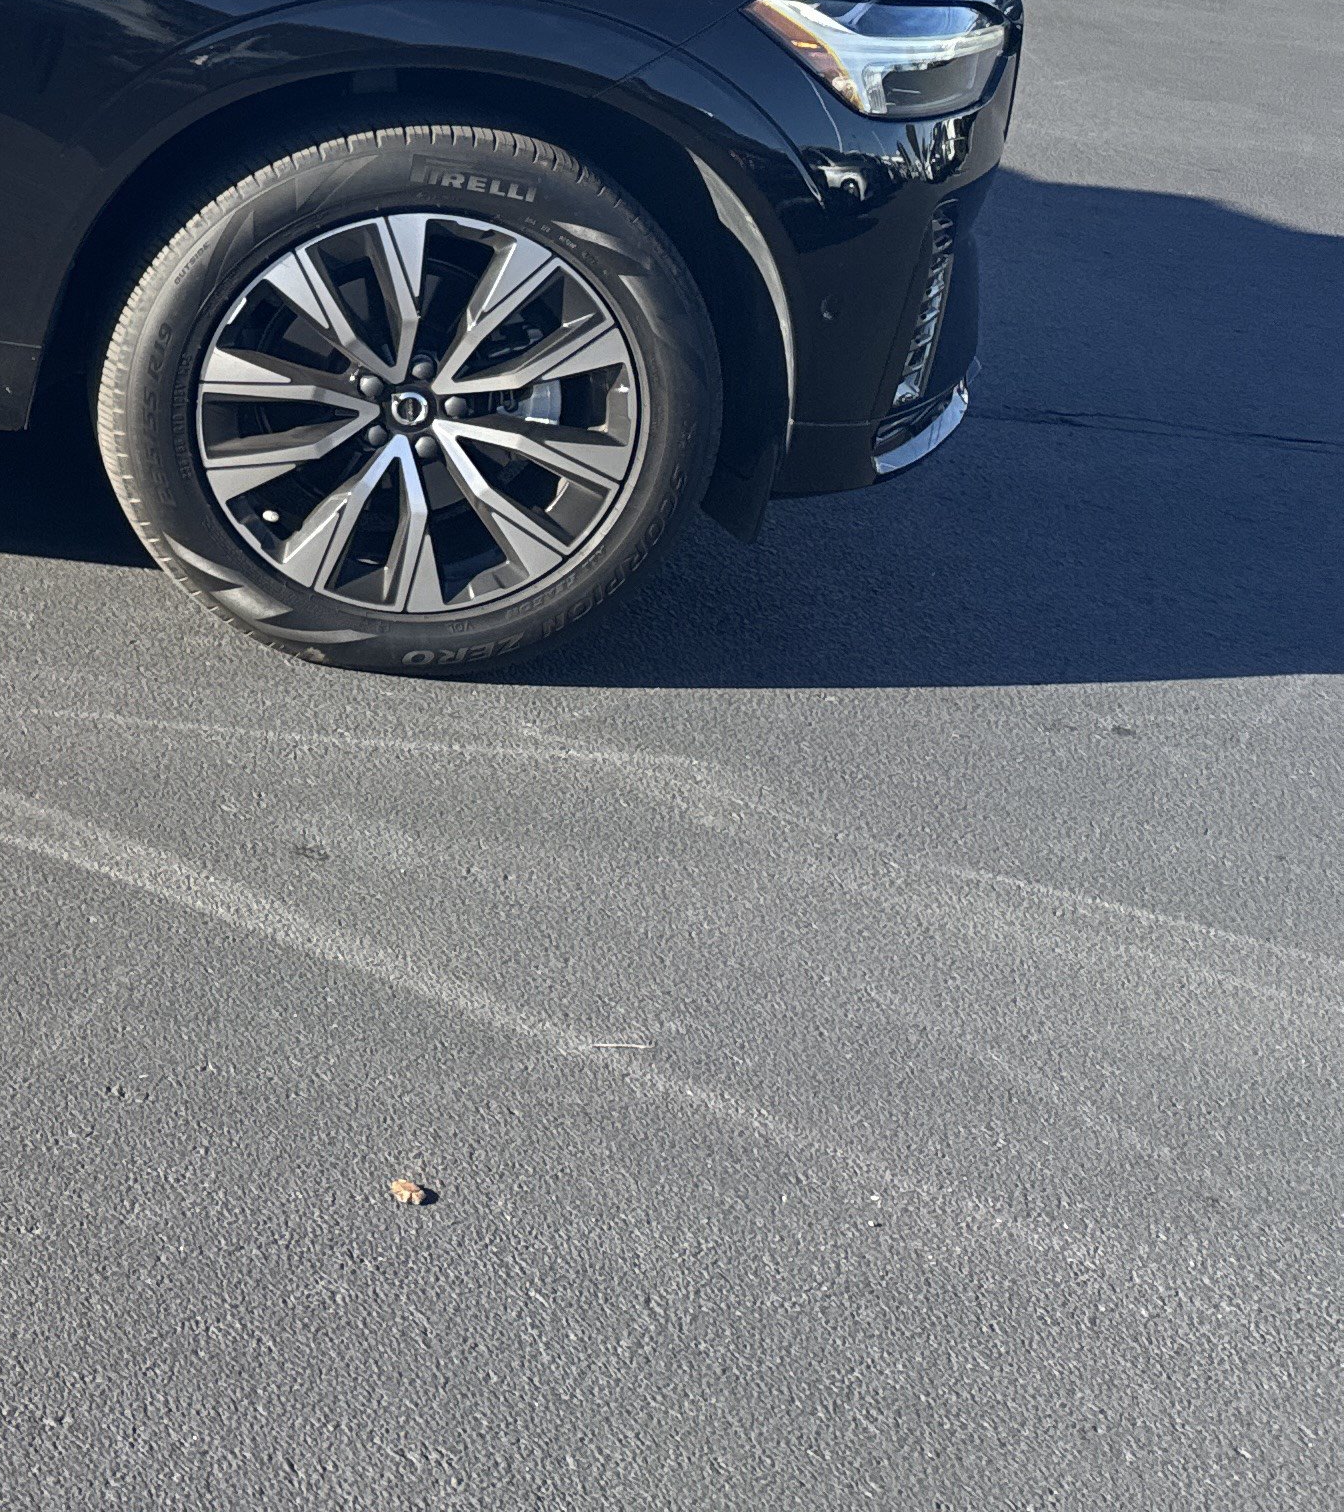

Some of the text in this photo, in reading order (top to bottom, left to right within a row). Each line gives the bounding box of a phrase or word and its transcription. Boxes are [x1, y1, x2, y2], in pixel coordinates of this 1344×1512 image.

[410, 154, 538, 204] PIRELLI
[174, 240, 210, 286] OUTSIDE
[401, 631, 525, 667] ZERO
